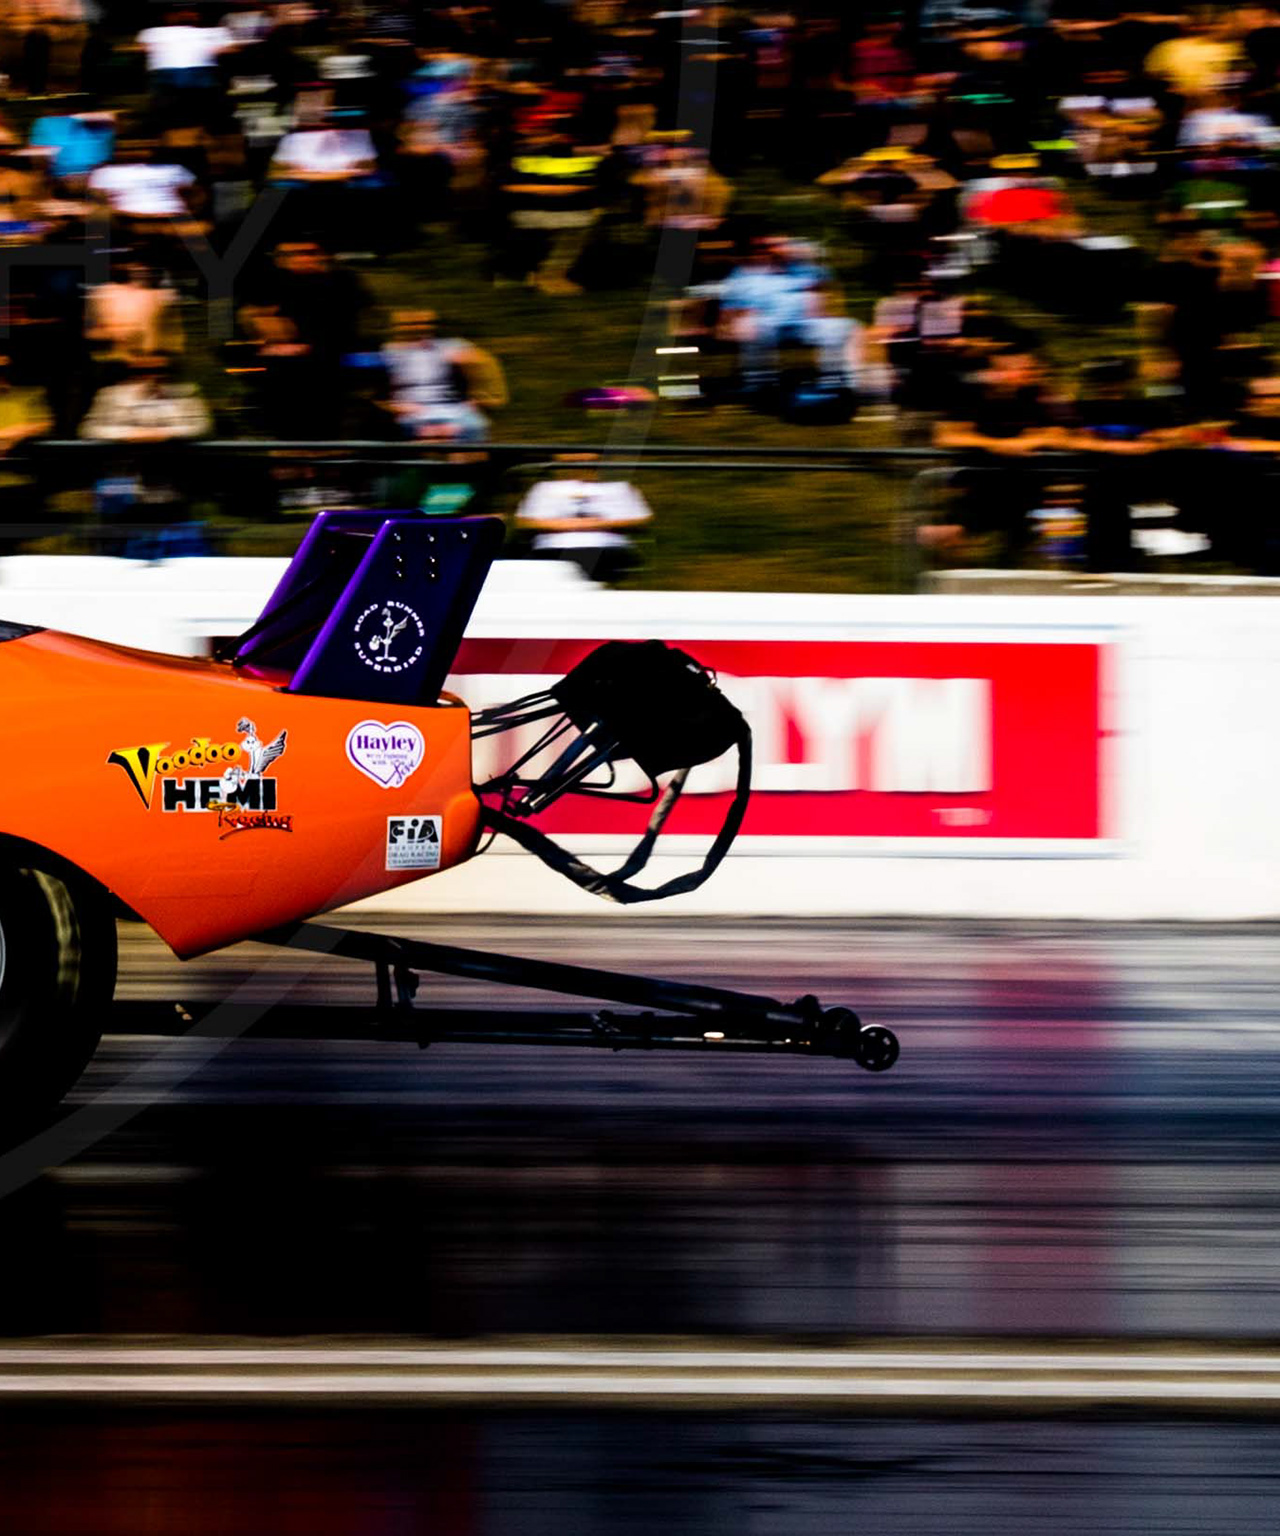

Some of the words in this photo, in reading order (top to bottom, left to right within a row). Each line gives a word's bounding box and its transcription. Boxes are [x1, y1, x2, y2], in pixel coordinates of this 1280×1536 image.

[353, 603, 379, 633] ROAD
[386, 600, 425, 637] RUNNER
[354, 642, 423, 673] SUPERBIRD
[357, 734, 417, 753] Hayley
[107, 737, 241, 810] Voodoo
[163, 778, 277, 811] HEMI
